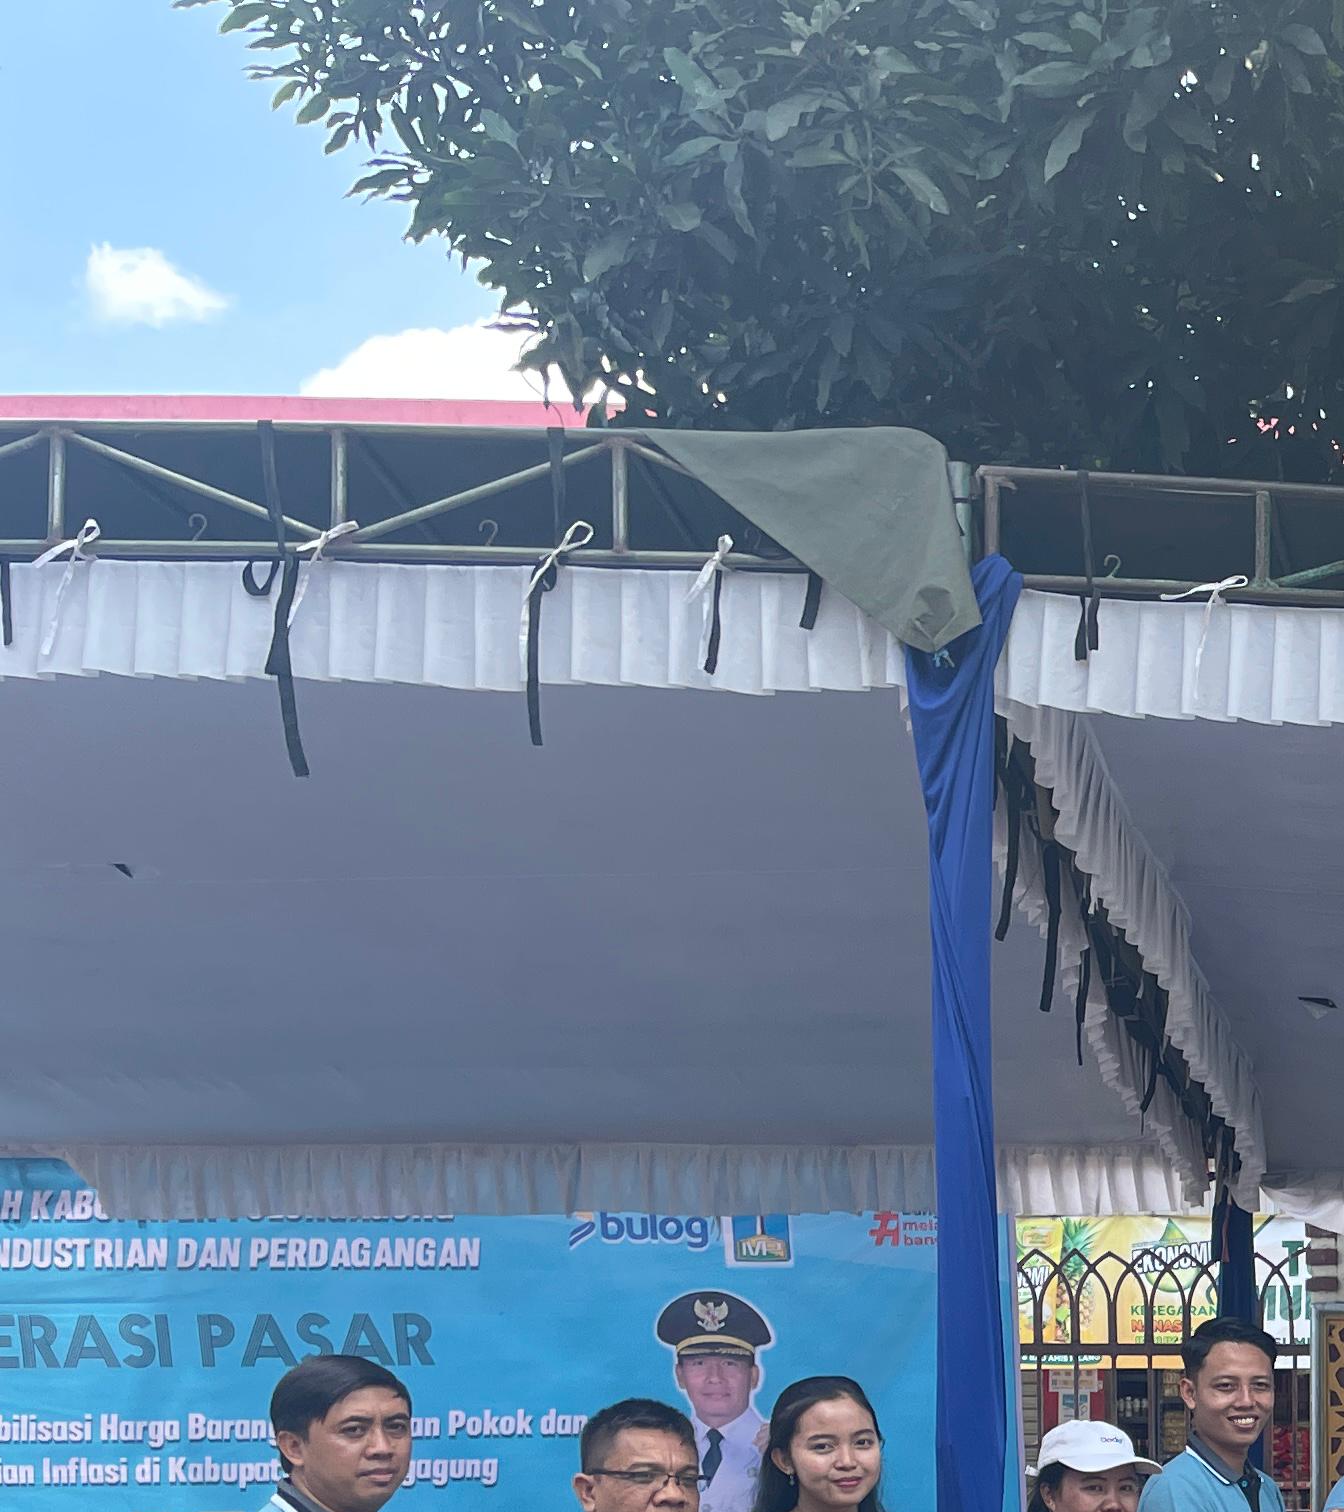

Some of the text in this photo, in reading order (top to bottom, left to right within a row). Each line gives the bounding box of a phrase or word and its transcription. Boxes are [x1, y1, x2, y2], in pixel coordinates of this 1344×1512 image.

[601, 1212, 708, 1248] bulog
[177, 1238, 241, 1270] DAN
[250, 1237, 481, 1270] PERDAGANGAN
[0, 1312, 435, 1368] ERASI PASAR
[0, 1414, 92, 1442] bilisasi
[100, 1413, 180, 1448] Harga
[448, 1408, 532, 1437] Pokok
[42, 1456, 128, 1486] Inflasi
[135, 1456, 161, 1485] di
[168, 1456, 283, 1491] Kabupat
